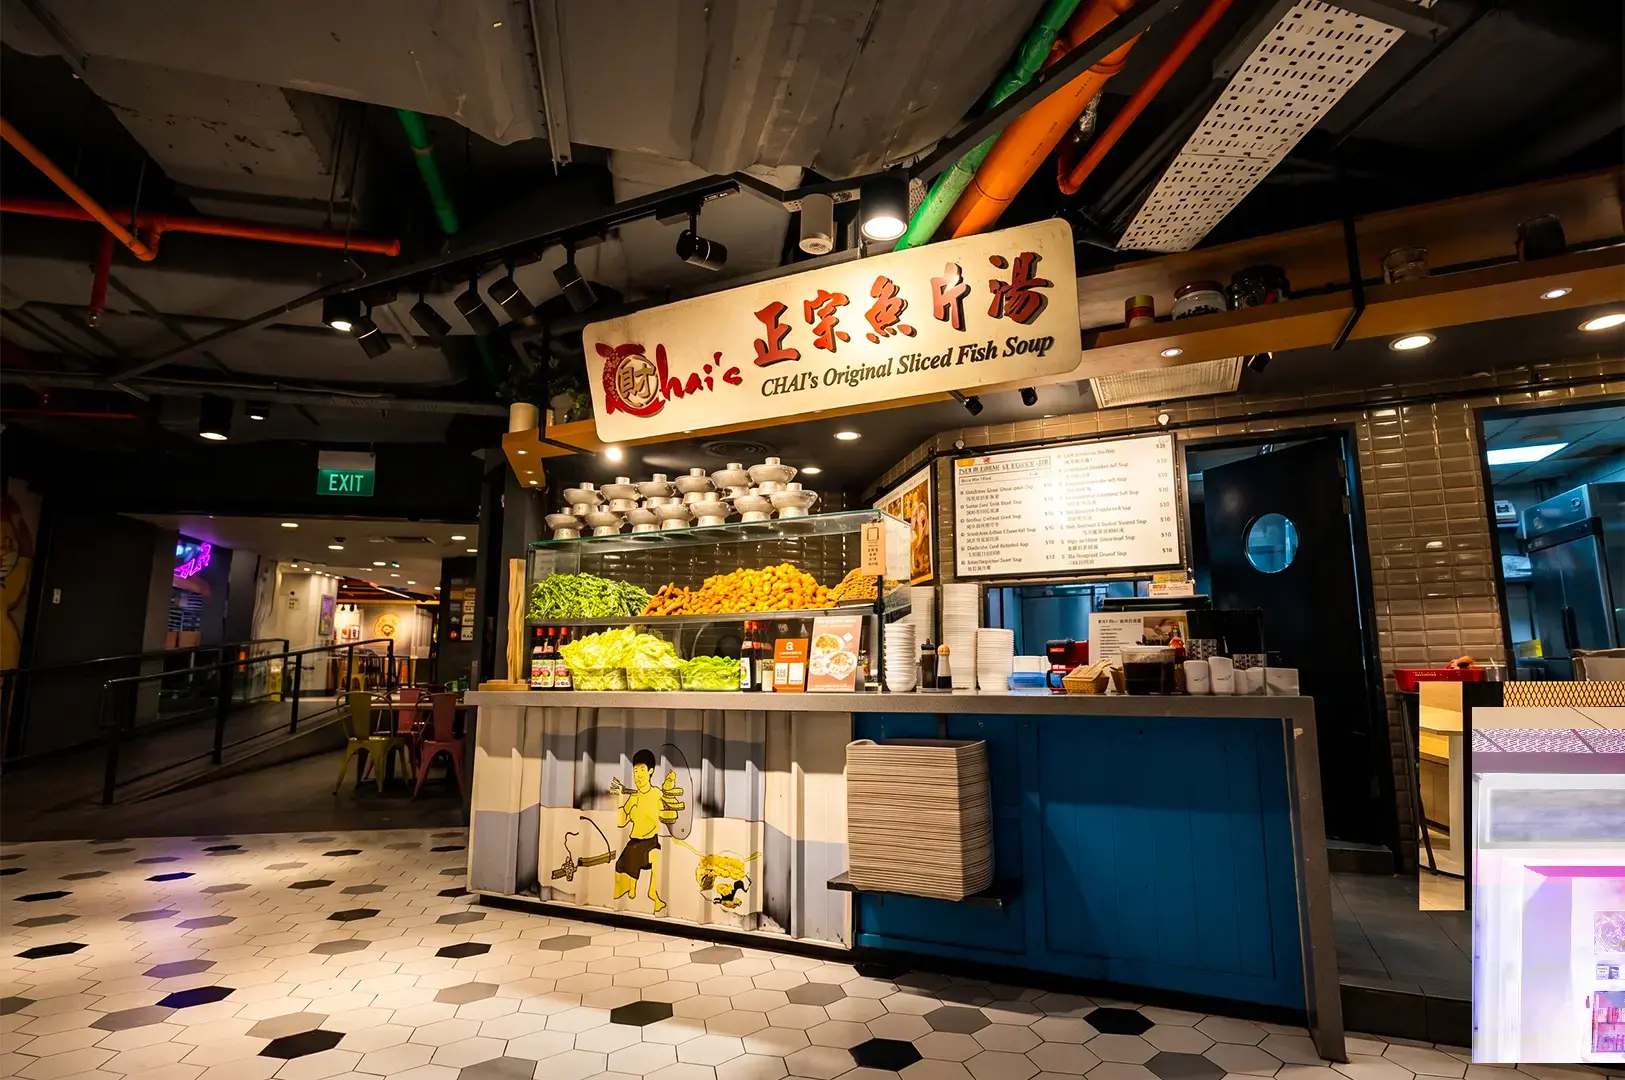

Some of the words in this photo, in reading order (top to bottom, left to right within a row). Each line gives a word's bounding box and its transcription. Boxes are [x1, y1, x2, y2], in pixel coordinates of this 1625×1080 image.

[754, 251, 1054, 367] 正宗魚片湯
[618, 362, 656, 400] 財
[761, 371, 818, 397] CHAI's
[823, 358, 893, 387] Original
[896, 347, 952, 374] Sliced
[955, 344, 998, 366] Fish
[1002, 335, 1055, 358] Soup
[329, 474, 364, 492] EXIT
